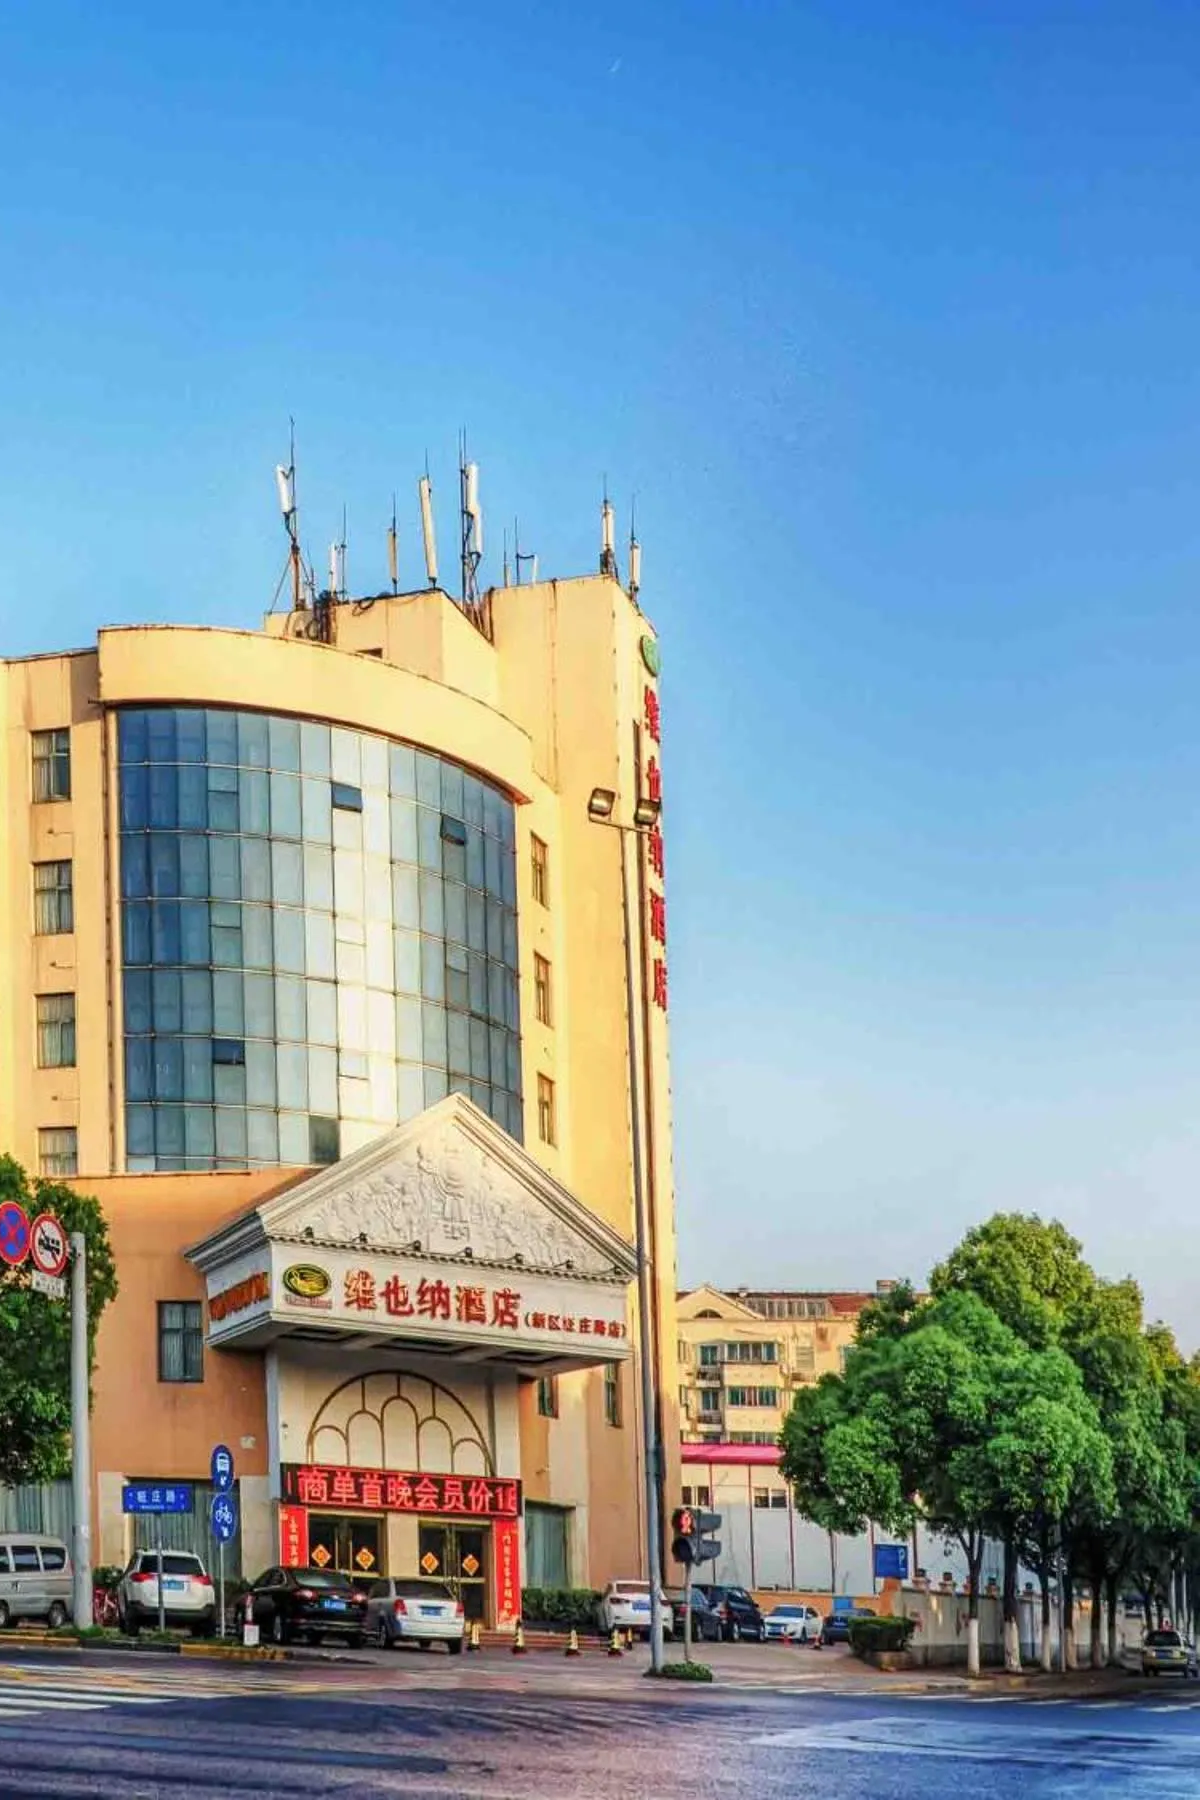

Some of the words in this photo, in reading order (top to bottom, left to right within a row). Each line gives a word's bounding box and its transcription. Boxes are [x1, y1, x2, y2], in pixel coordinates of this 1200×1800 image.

[343, 1270, 521, 1330] 维也纳酒店
